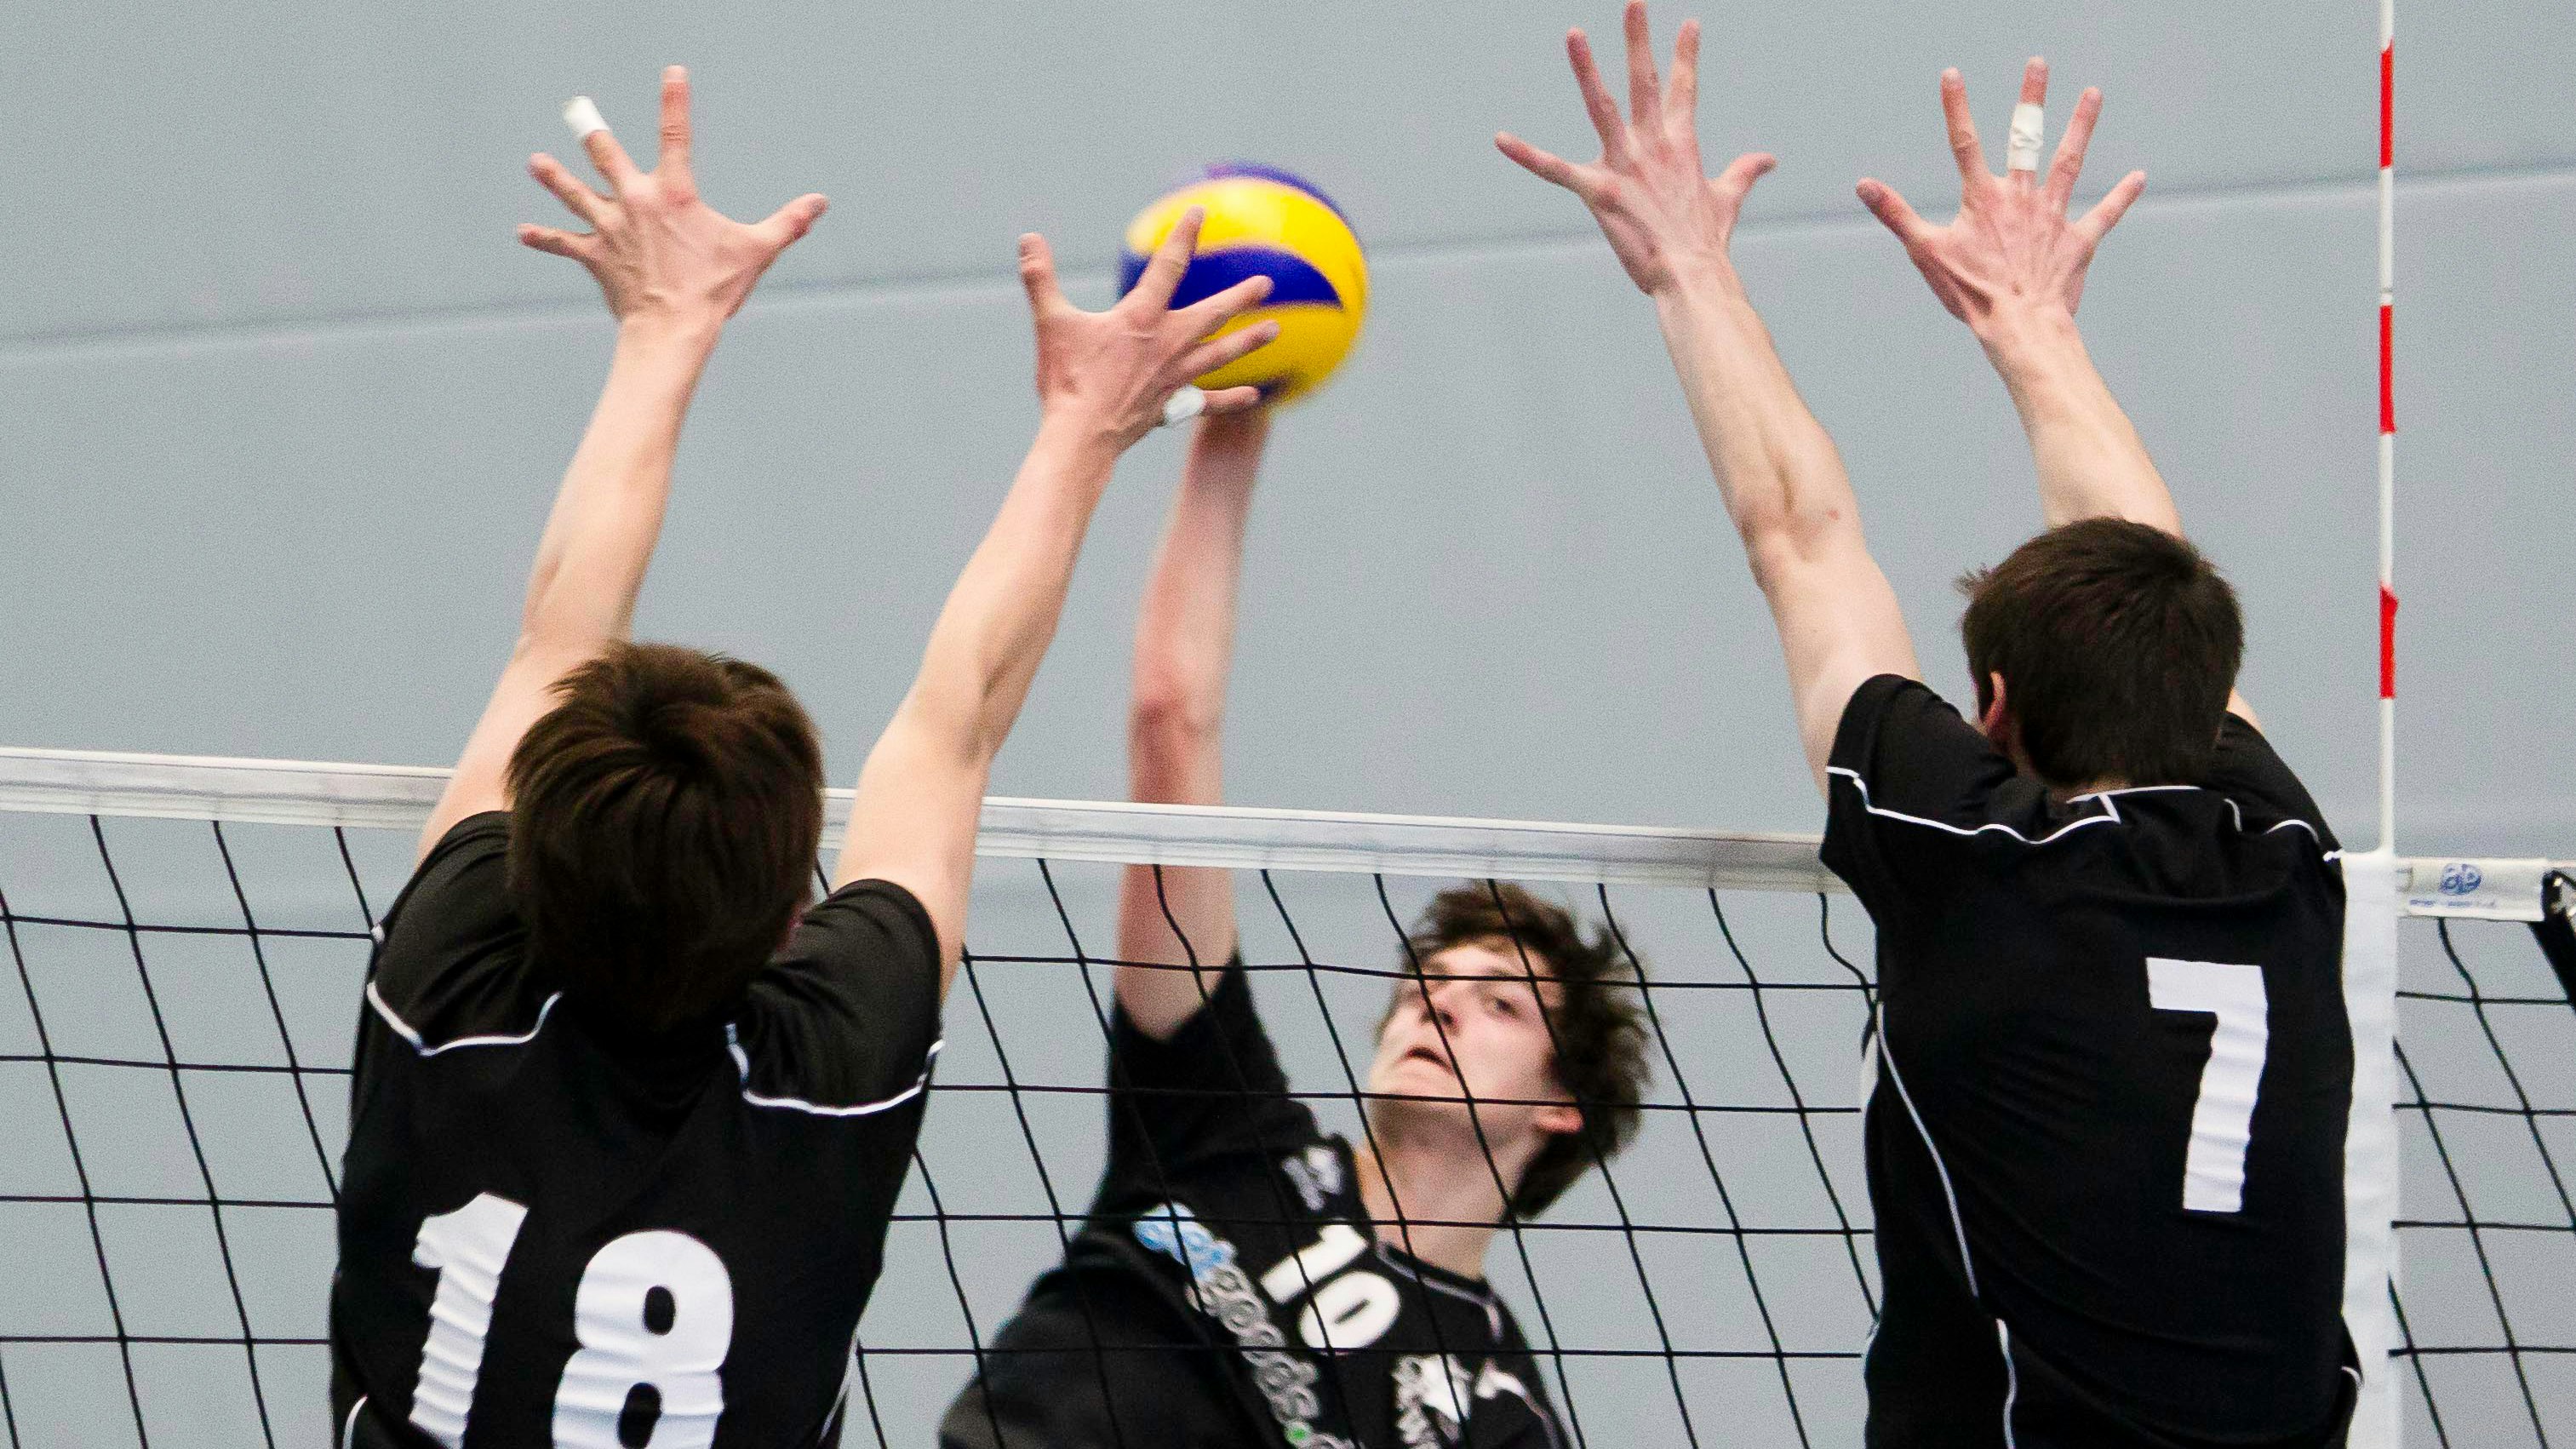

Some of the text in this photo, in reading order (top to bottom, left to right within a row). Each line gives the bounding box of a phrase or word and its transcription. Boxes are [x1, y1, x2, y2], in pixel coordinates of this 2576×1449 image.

[2145, 957, 2270, 1213] 7
[409, 1192, 735, 1449] 18
[1259, 1217, 1401, 1354] 10
